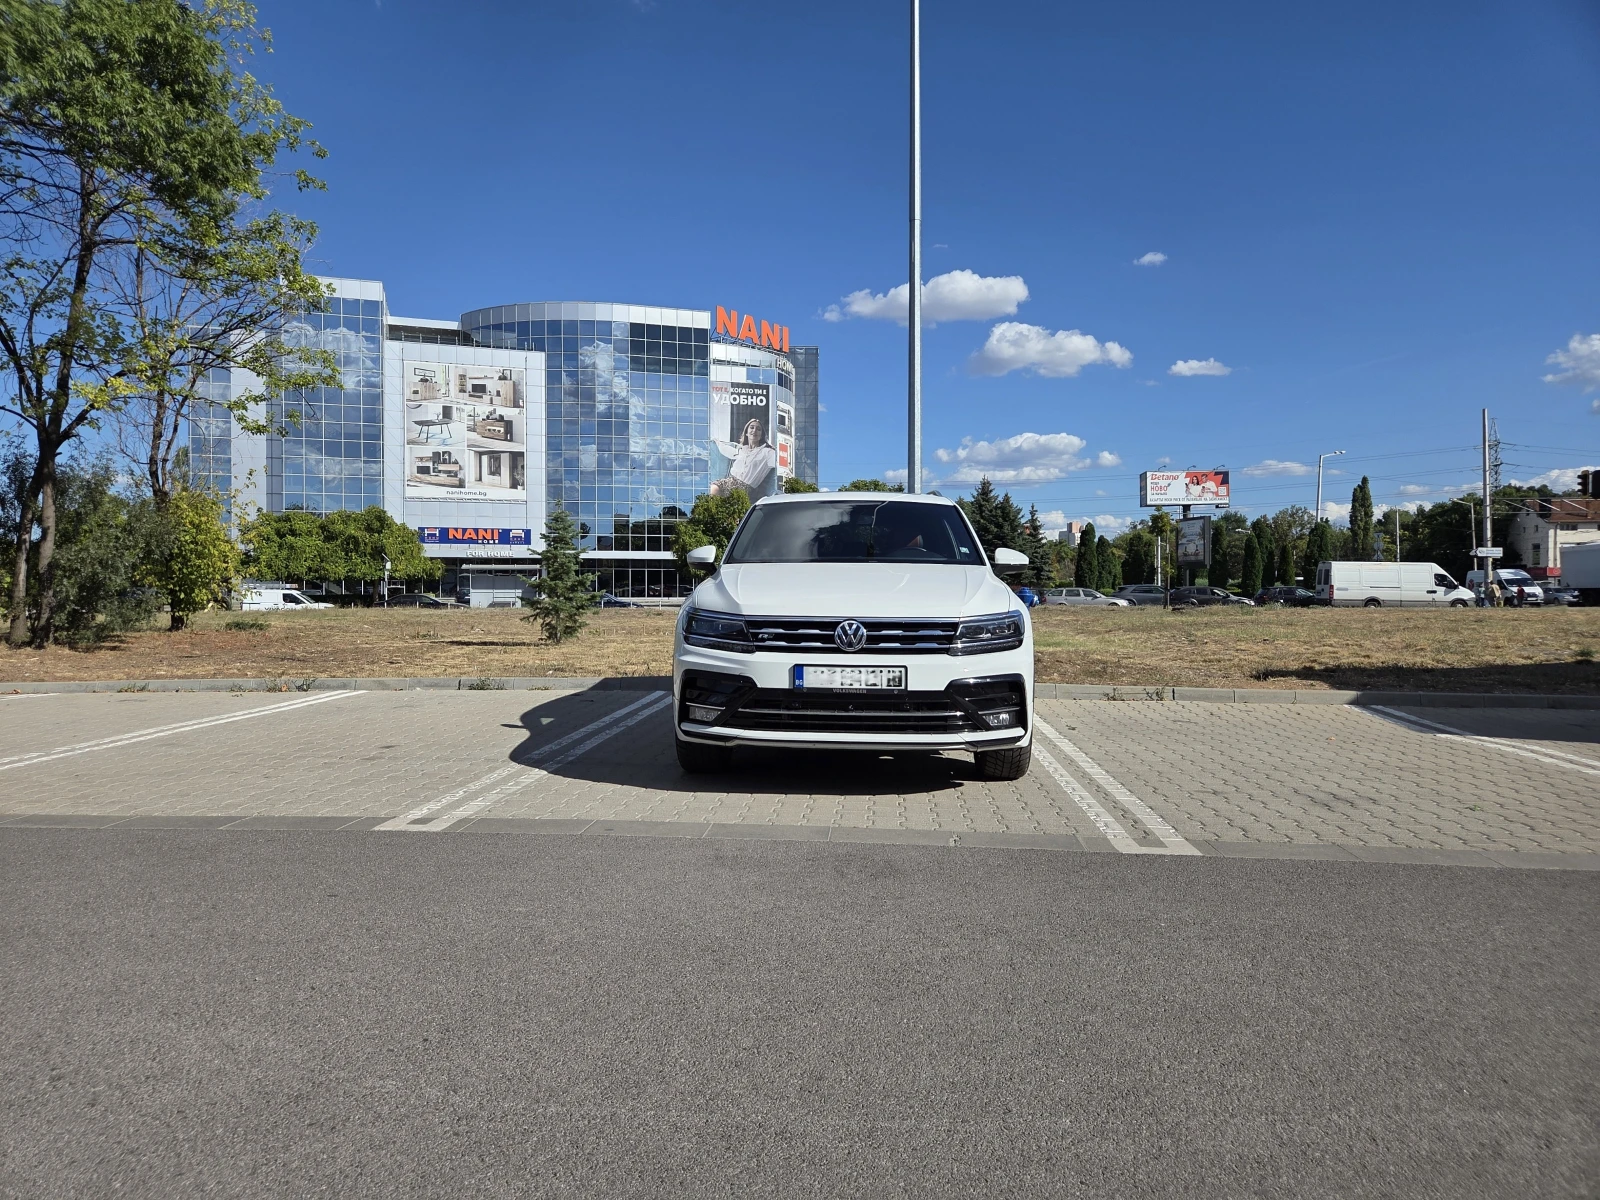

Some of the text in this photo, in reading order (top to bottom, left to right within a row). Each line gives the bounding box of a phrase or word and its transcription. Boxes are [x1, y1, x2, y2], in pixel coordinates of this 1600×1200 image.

[716, 305, 789, 353] NANI
[712, 394, 767, 406] УДОБНО
[448, 527, 499, 540] NANI
[487, 550, 514, 558] HOME
